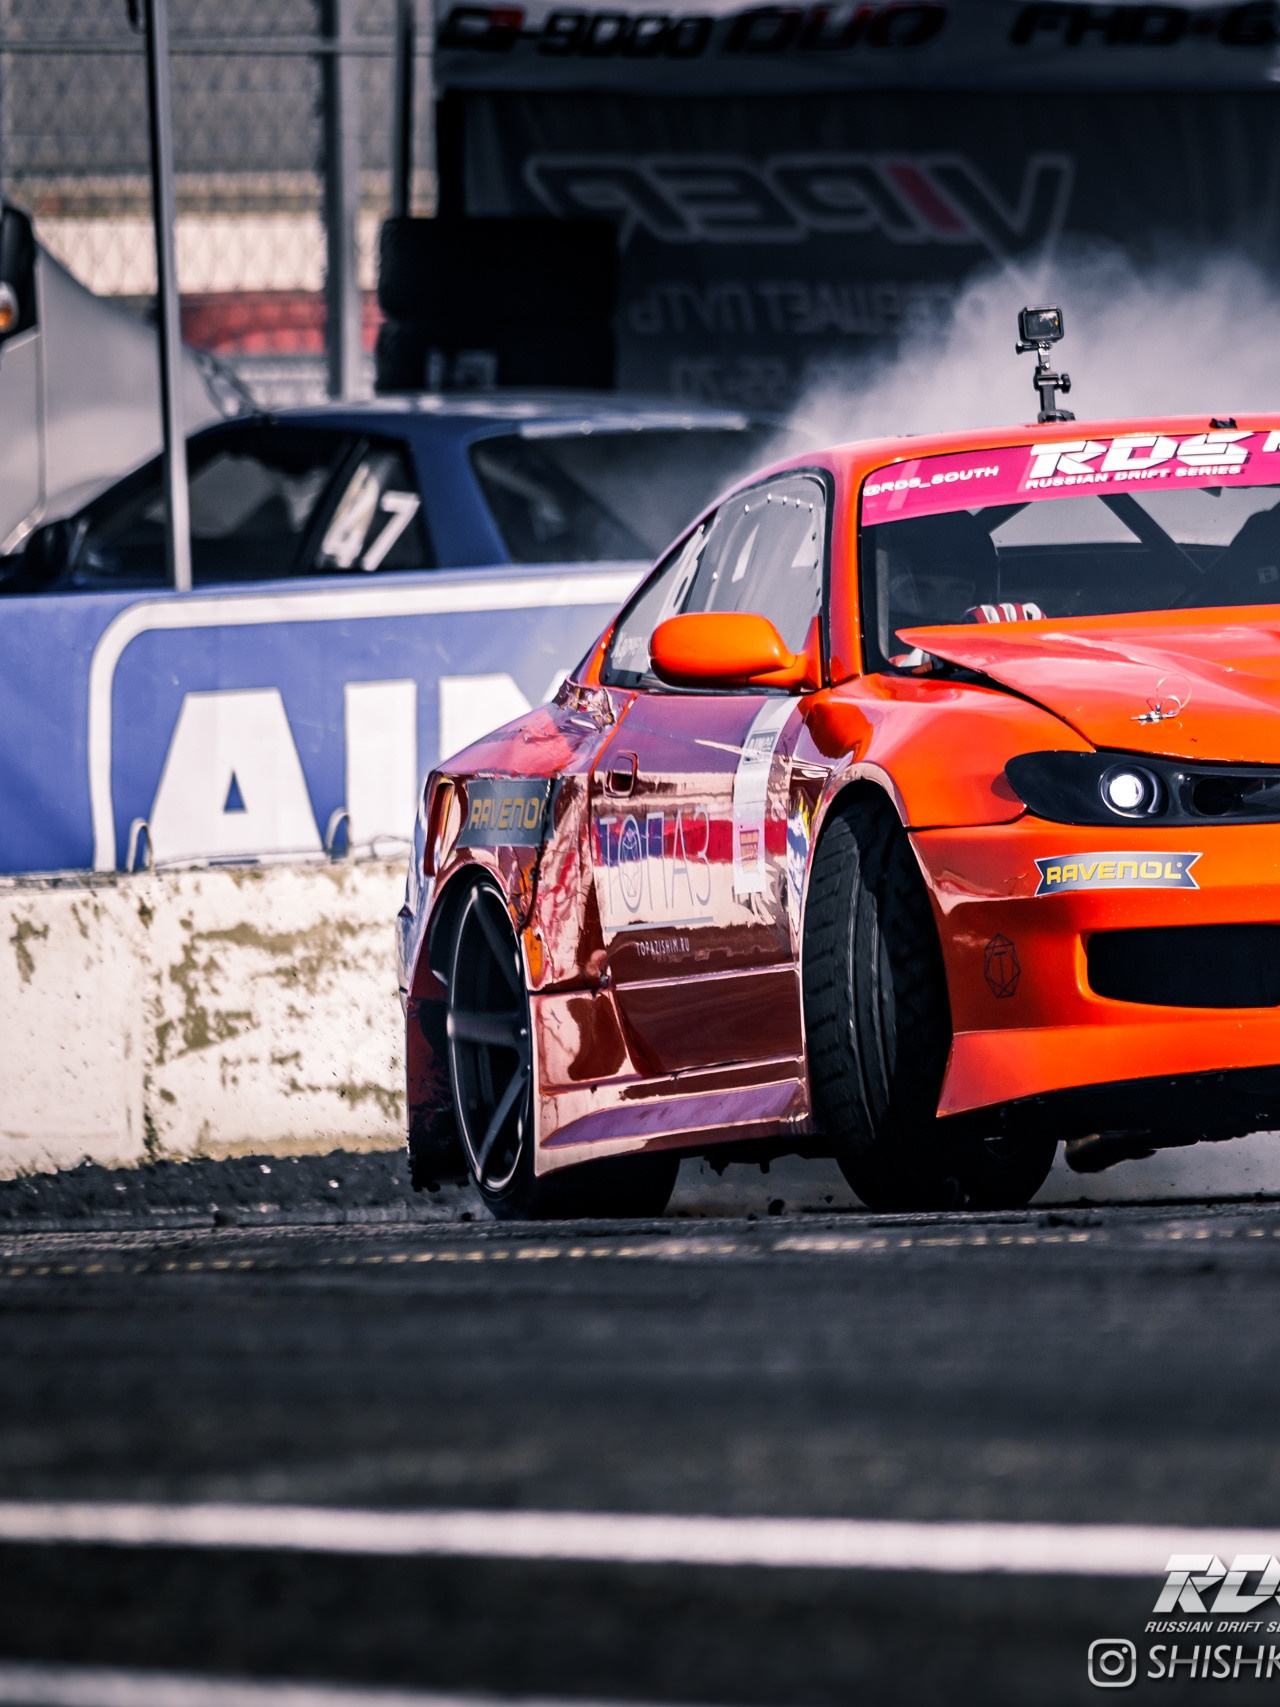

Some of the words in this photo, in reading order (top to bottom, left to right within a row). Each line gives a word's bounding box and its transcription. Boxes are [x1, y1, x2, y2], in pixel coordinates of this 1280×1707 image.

[721, 4, 948, 54] DUO
[1030, 431, 1254, 479] RDS
[863, 465, 999, 497] @RDS_SOUTH
[1025, 472, 1108, 490] RUSSIAN
[1112, 467, 1170, 481] DRIFT
[1175, 465, 1242, 477] SERIES
[600, 806, 712, 914] ТОПАЗ
[1046, 861, 1182, 885] RAVENOL
